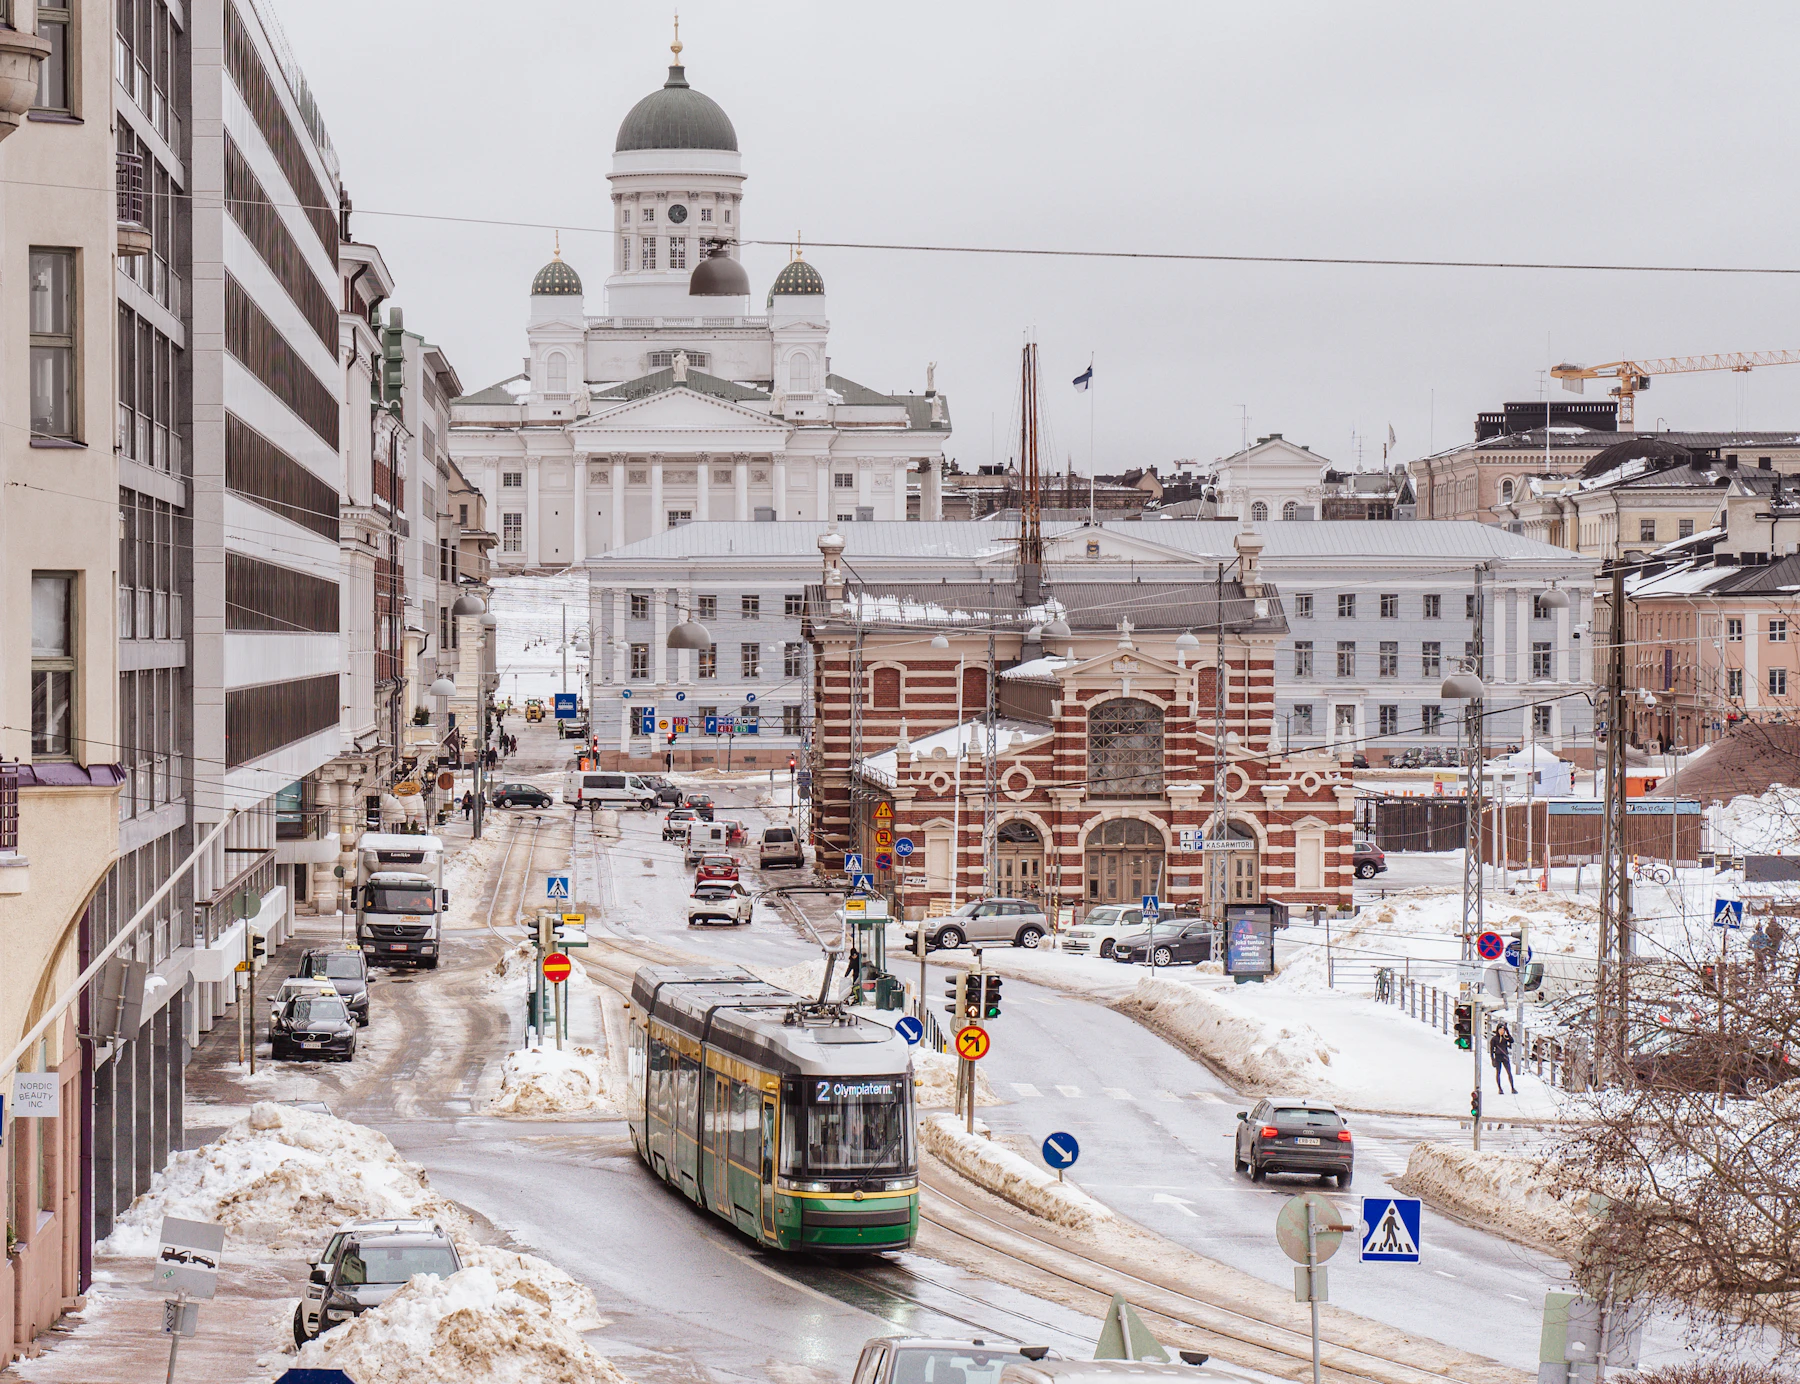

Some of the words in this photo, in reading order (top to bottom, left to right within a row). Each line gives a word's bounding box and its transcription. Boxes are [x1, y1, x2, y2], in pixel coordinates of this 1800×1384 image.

[20, 1082, 53, 1090] NORDIC
[817, 1081, 831, 1101] 2
[833, 1083, 893, 1097] Olympiaterm.
[19, 1092, 53, 1101] BEAUTY
